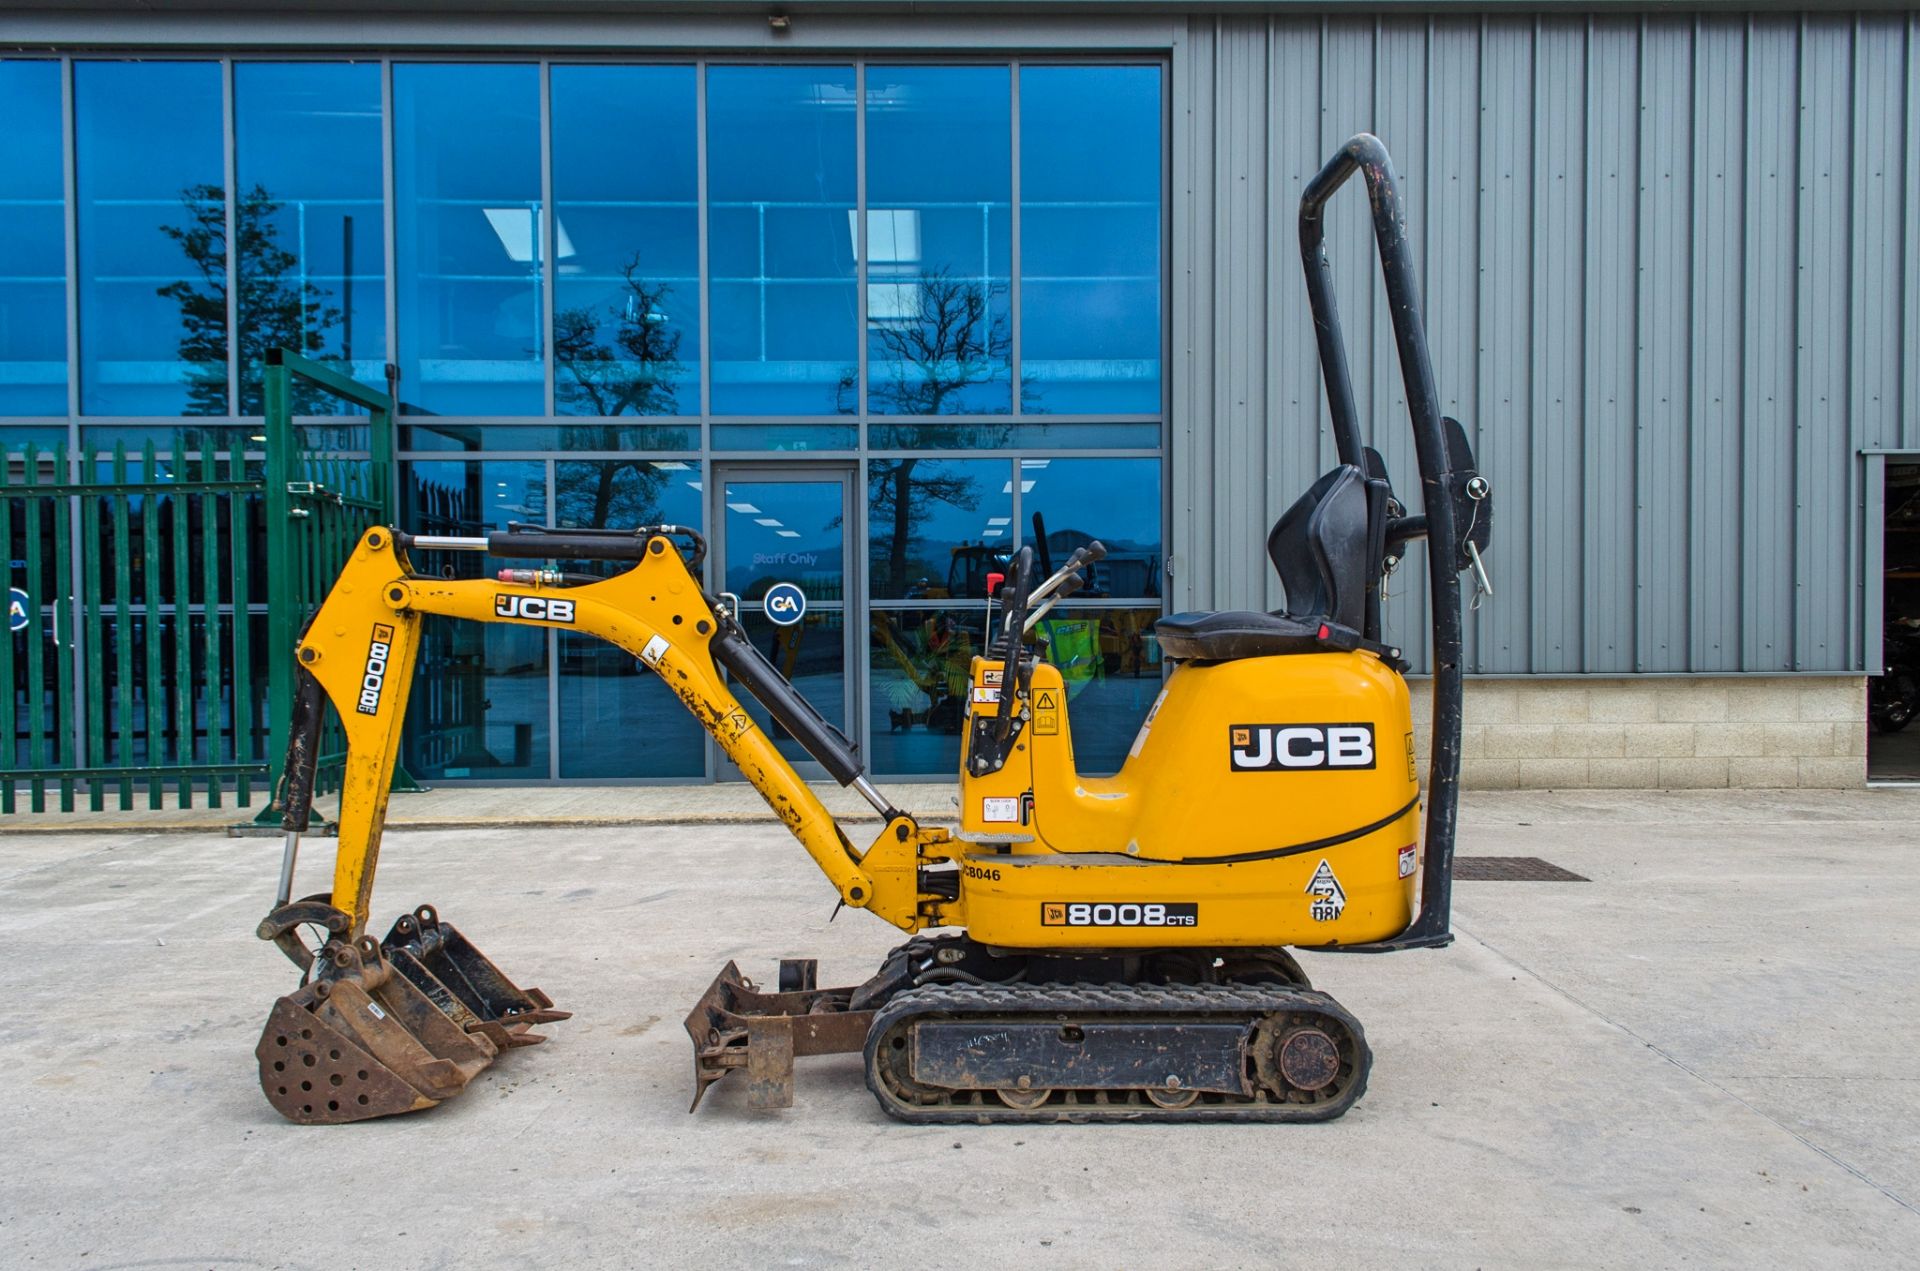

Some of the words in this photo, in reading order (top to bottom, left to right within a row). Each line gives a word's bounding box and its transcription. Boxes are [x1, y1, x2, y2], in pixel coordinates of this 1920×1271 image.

[753, 553, 785, 564] Staff
[789, 553, 818, 566] Only
[496, 596, 574, 622] JCB
[360, 642, 390, 707] 8008
[1233, 727, 1374, 767] JCB
[1313, 888, 1335, 905] 52
[1068, 904, 1166, 925] 8008
